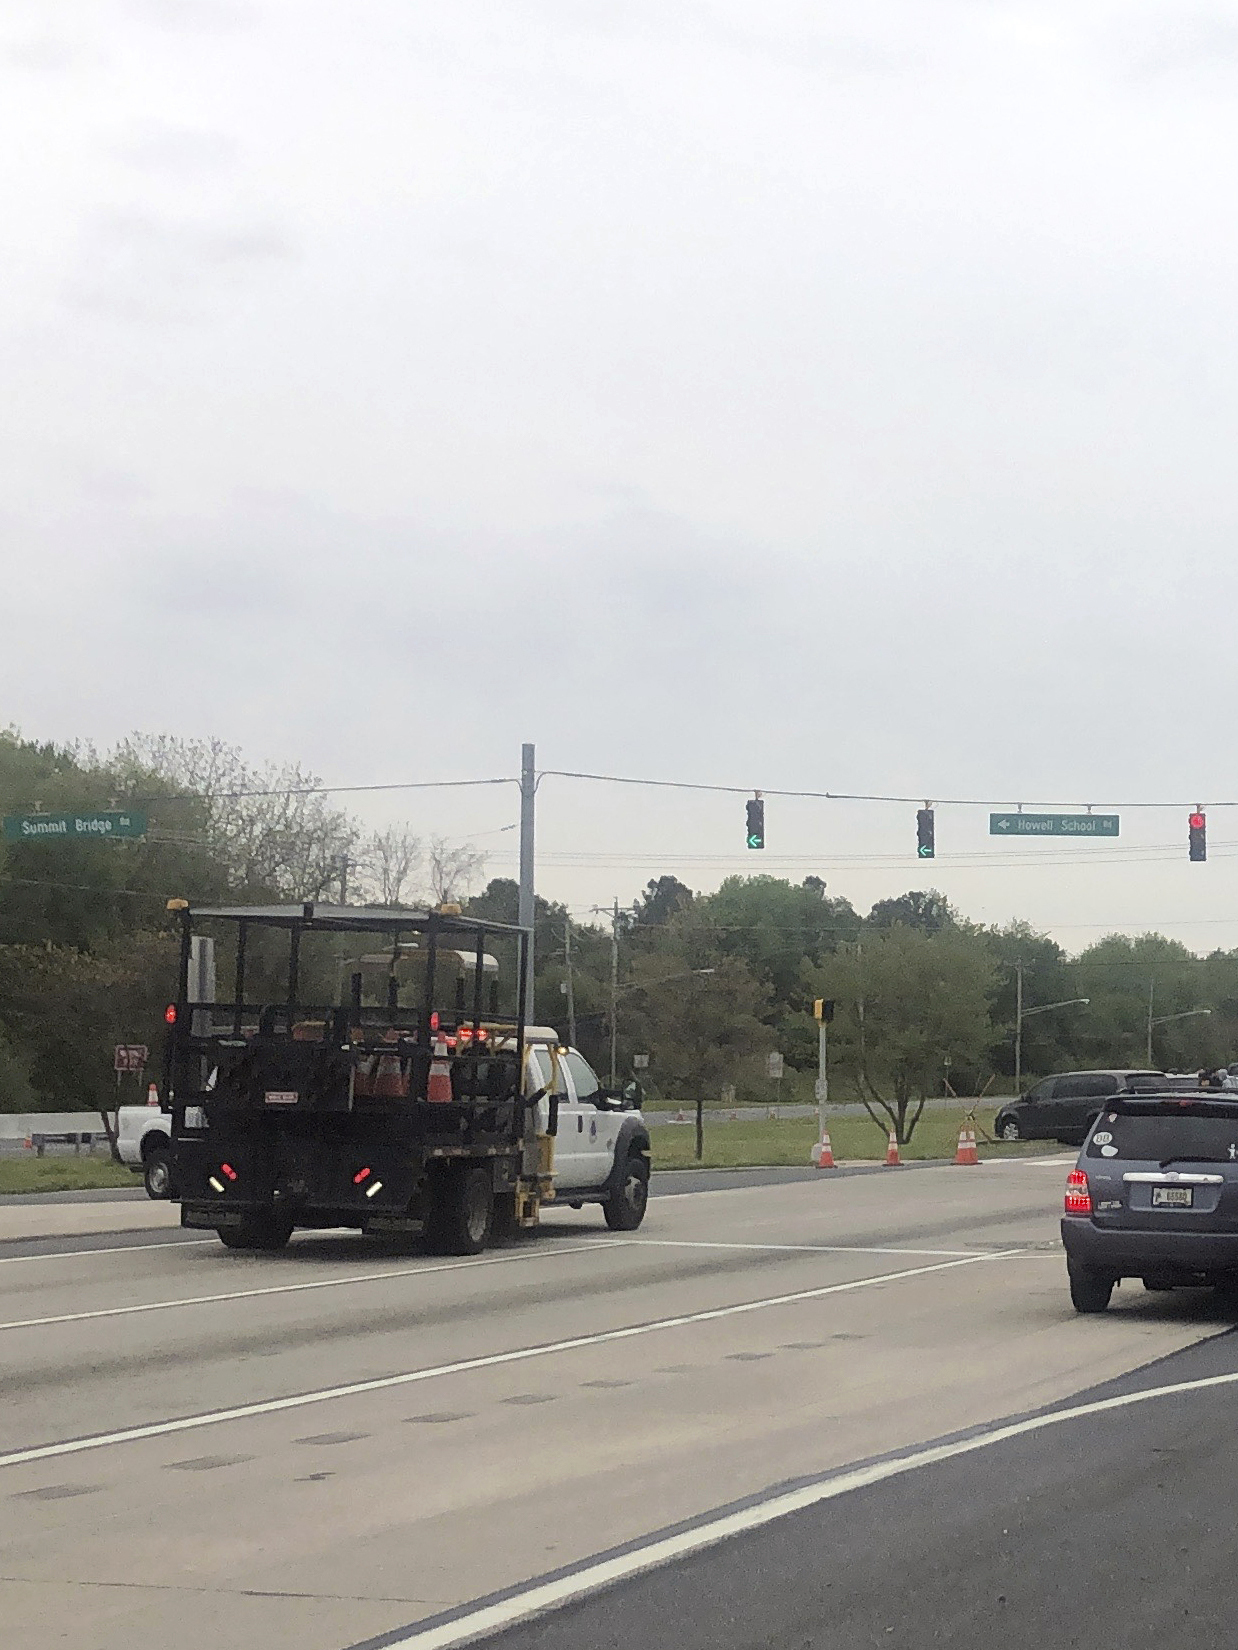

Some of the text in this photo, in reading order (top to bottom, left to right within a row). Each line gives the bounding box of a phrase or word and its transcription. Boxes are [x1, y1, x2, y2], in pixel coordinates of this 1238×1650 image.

[22, 820, 67, 835] Summit
[75, 818, 112, 834] Bridge
[1017, 820, 1054, 831] Howell
[1061, 819, 1096, 832] School
